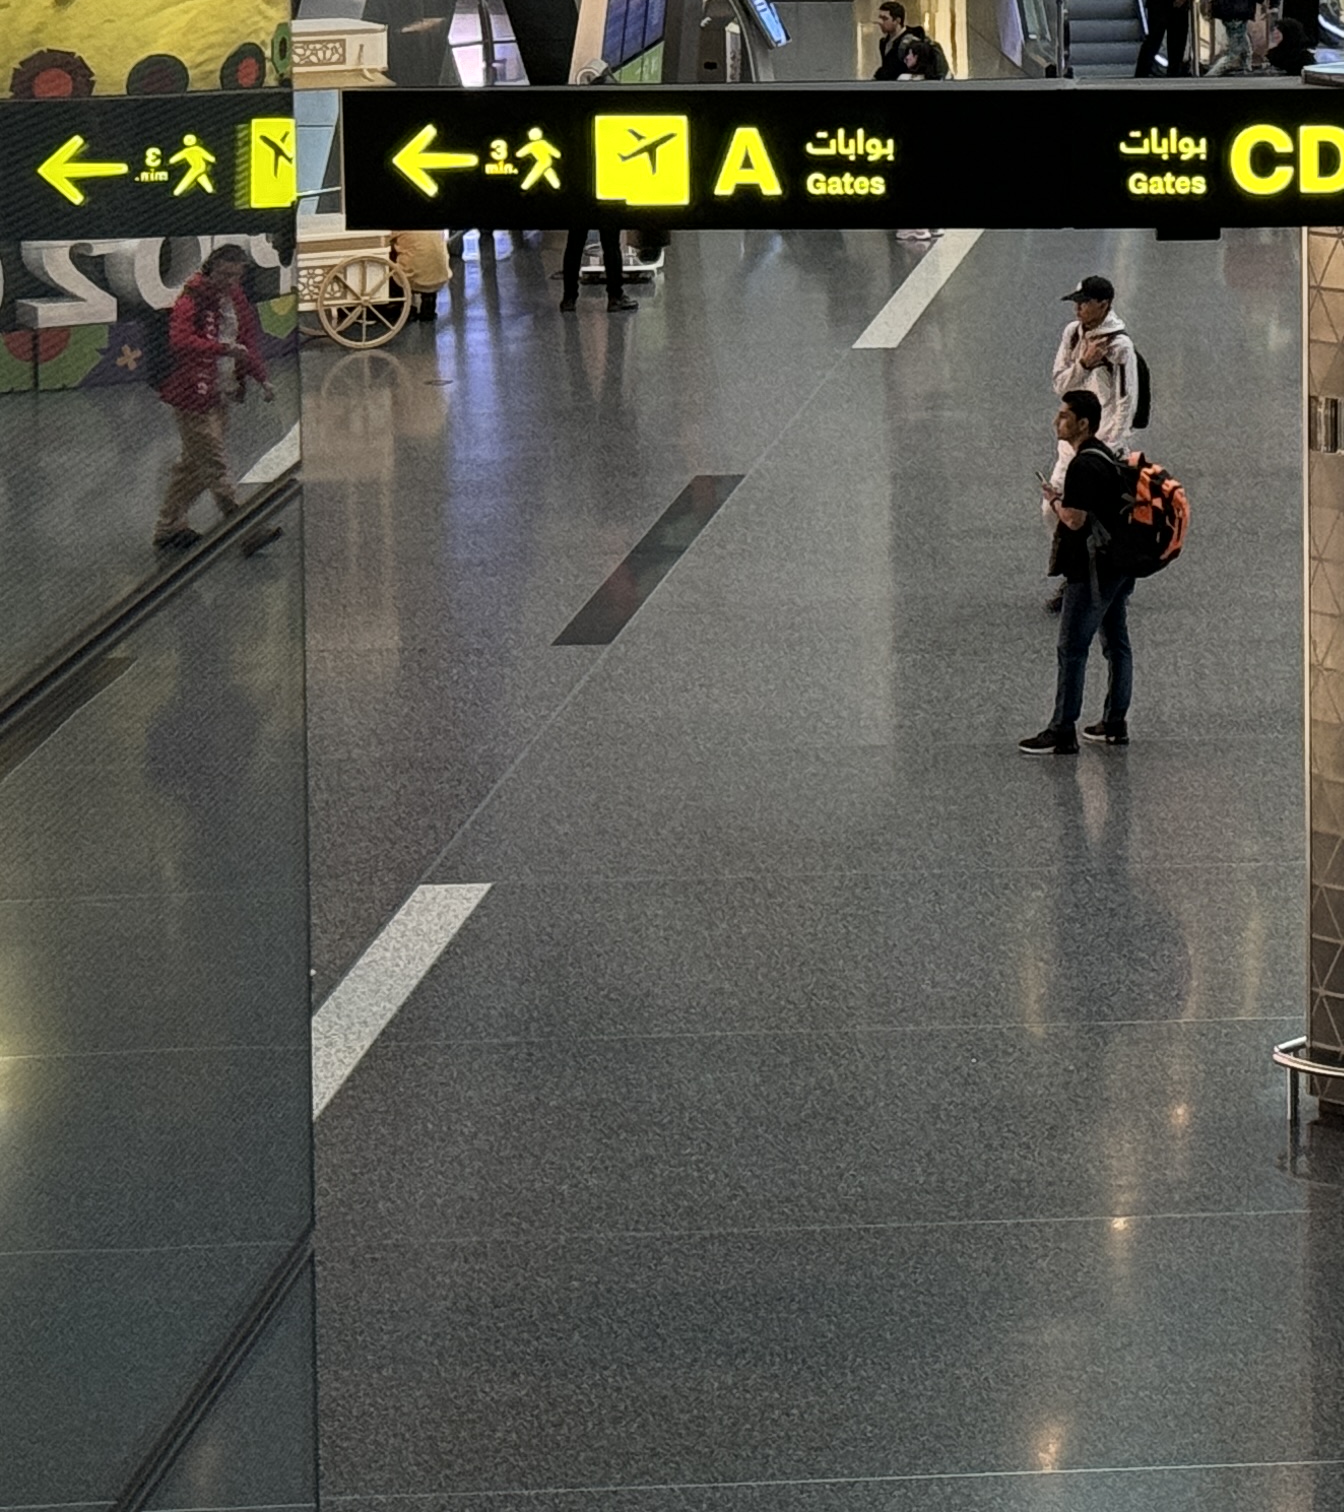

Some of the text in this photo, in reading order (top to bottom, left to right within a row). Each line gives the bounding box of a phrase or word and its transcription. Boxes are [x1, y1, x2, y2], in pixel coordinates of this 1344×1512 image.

[490, 139, 508, 161] 3
[806, 127, 896, 163] بوابات
[1118, 127, 1208, 162] بوابات
[485, 161, 519, 176] min.
[713, 126, 783, 196] A
[806, 171, 887, 197] Gates
[1127, 172, 1207, 196] Gates
